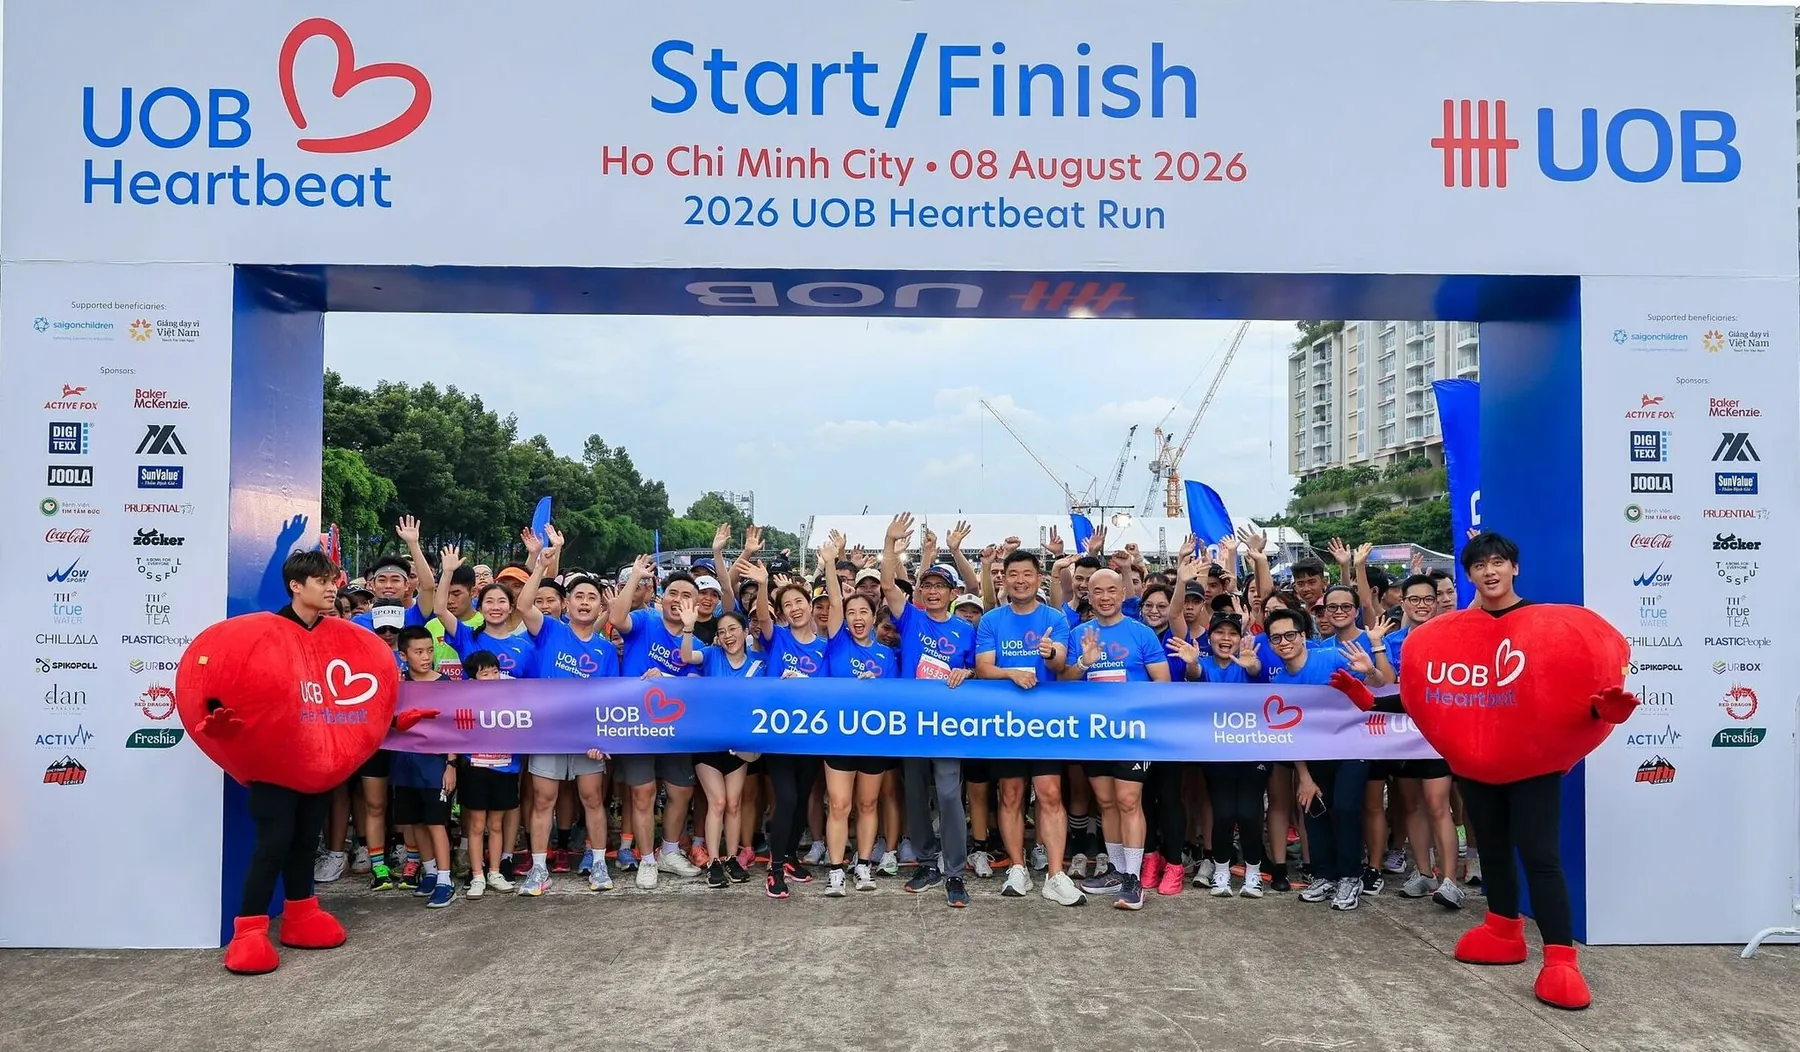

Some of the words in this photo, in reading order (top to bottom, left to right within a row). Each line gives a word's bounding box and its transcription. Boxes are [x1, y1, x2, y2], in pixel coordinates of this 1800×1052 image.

[650, 33, 1198, 128] Start/Finish
[82, 87, 252, 149] UOB
[1537, 107, 1742, 183] UOB
[601, 145, 654, 178] Ho
[666, 145, 724, 179] Chi
[737, 147, 829, 180] Minh
[843, 147, 914, 186] City
[949, 149, 999, 181] 08
[1009, 150, 1142, 188] August
[1153, 152, 1247, 183] 2026
[84, 158, 392, 208] Heartbeat
[684, 196, 778, 228] 2026
[791, 198, 875, 228] UOB
[890, 198, 1084, 229] Heartbeat
[1099, 200, 1165, 229] Run
[685, 281, 984, 308] UOB
[71, 301, 113, 311] Supported
[115, 302, 167, 311] beneficiaries:
[1647, 313, 1686, 323] Supported
[1688, 313, 1738, 322] beneficiaries:
[53, 320, 114, 330] saigonchildren
[157, 328, 176, 338] Việt
[177, 329, 200, 337] Nam
[1631, 333, 1688, 342] saigonchildren
[1728, 339, 1747, 348] Việt
[1748, 339, 1770, 348] Nam
[100, 367, 136, 375] Sponsors:
[1676, 377, 1710, 385] Sponsors:
[135, 389, 167, 399] Baker
[44, 402, 77, 410] ACTIVE
[79, 402, 98, 410] FOX
[134, 399, 190, 409] McKenzie.
[1709, 398, 1740, 407] Baker
[1625, 411, 1656, 419] ACTIVE
[1658, 411, 1675, 419] FOX
[1708, 408, 1762, 417] McKenzie.
[53, 426, 77, 438] DIGI
[53, 441, 76, 450] TEXX
[1634, 435, 1656, 446] DIGI
[1634, 450, 1656, 458] TEXX
[50, 469, 91, 483] JOOLA
[142, 468, 178, 480] SunValue
[1632, 476, 1671, 490] JOOLA
[1718, 475, 1753, 487] SunValue
[124, 503, 180, 512] PRUDENTIAL
[1703, 510, 1756, 518] PRUDENTIAL
[54, 593, 70, 602] TH
[146, 594, 160, 602] TH
[1640, 597, 1656, 605] TH
[1726, 597, 1740, 605] TH
[53, 604, 82, 615] true
[146, 604, 170, 614] true
[1640, 607, 1667, 619] true
[1726, 606, 1750, 617] true
[53, 616, 83, 624] WATER
[146, 614, 170, 625] TEA
[1640, 619, 1667, 627] WATER
[1727, 616, 1750, 627] TEA
[36, 634, 98, 645] CHILLALA
[122, 635, 192, 647] PLASTICPeople
[1001, 640, 1023, 649] UOB
[1626, 637, 1682, 647] CHILLALA
[1705, 637, 1771, 648] PLASTICPeople
[651, 642, 671, 658] UOB
[924, 647, 950, 662] artbeat
[557, 651, 577, 667] UOB
[1091, 660, 1125, 669] eartbeat
[146, 662, 179, 671] URBOX
[555, 660, 590, 679] Heartbeat
[1727, 663, 1761, 671] URBOX
[1426, 661, 1489, 687] UOB
[44, 684, 86, 705] dan
[479, 709, 533, 730] UOB
[595, 706, 640, 723] UOB
[1213, 711, 1257, 729] UOB
[596, 723, 675, 737] Heartbeat
[751, 709, 829, 735] 2026
[838, 710, 907, 736] UOB
[917, 711, 1079, 739] Heartbeat
[1090, 713, 1147, 740] Run
[135, 731, 176, 744] Freshia
[1214, 729, 1294, 744] Heartbeat
[1720, 729, 1759, 743] Freshia
